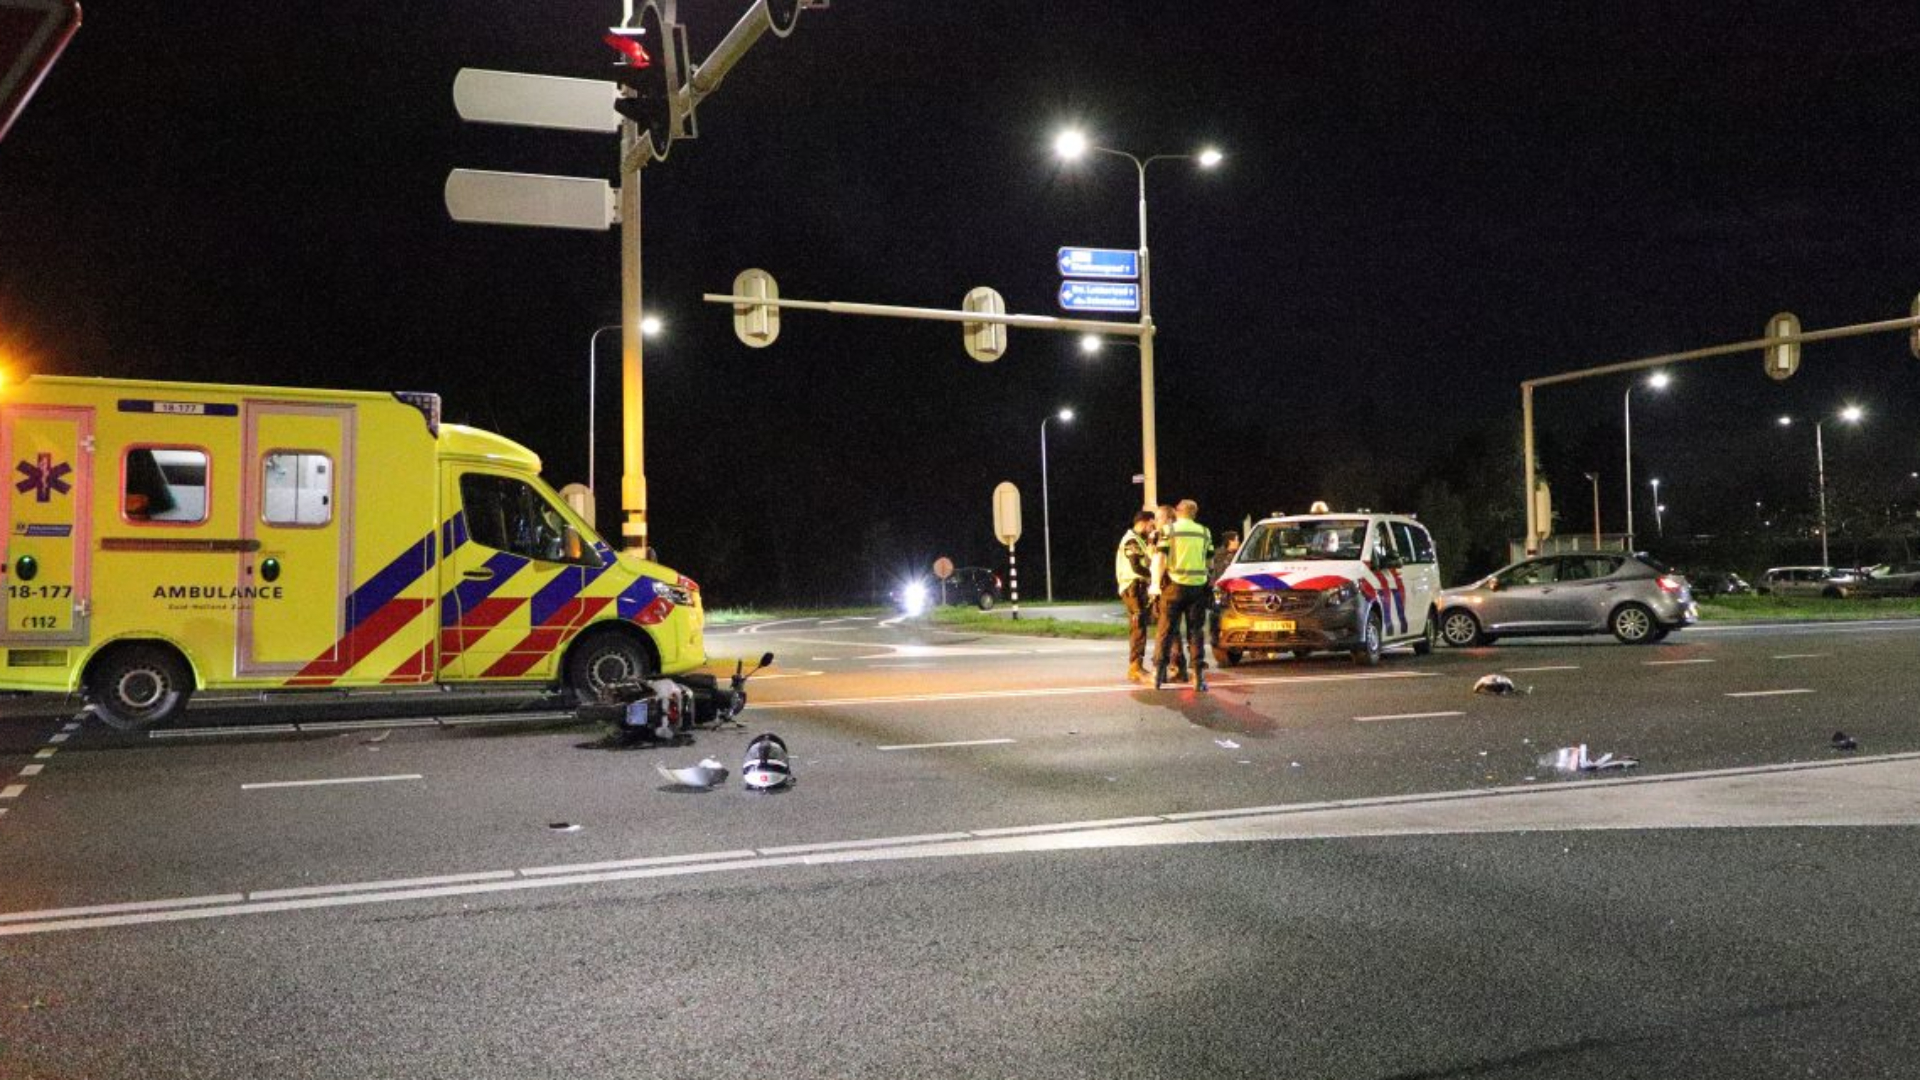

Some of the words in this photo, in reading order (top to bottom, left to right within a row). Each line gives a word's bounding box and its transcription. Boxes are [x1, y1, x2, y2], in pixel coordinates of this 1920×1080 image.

[163, 404, 196, 412] 18-177
[8, 585, 72, 598] 18-177
[153, 586, 283, 599] AMBULANCE
